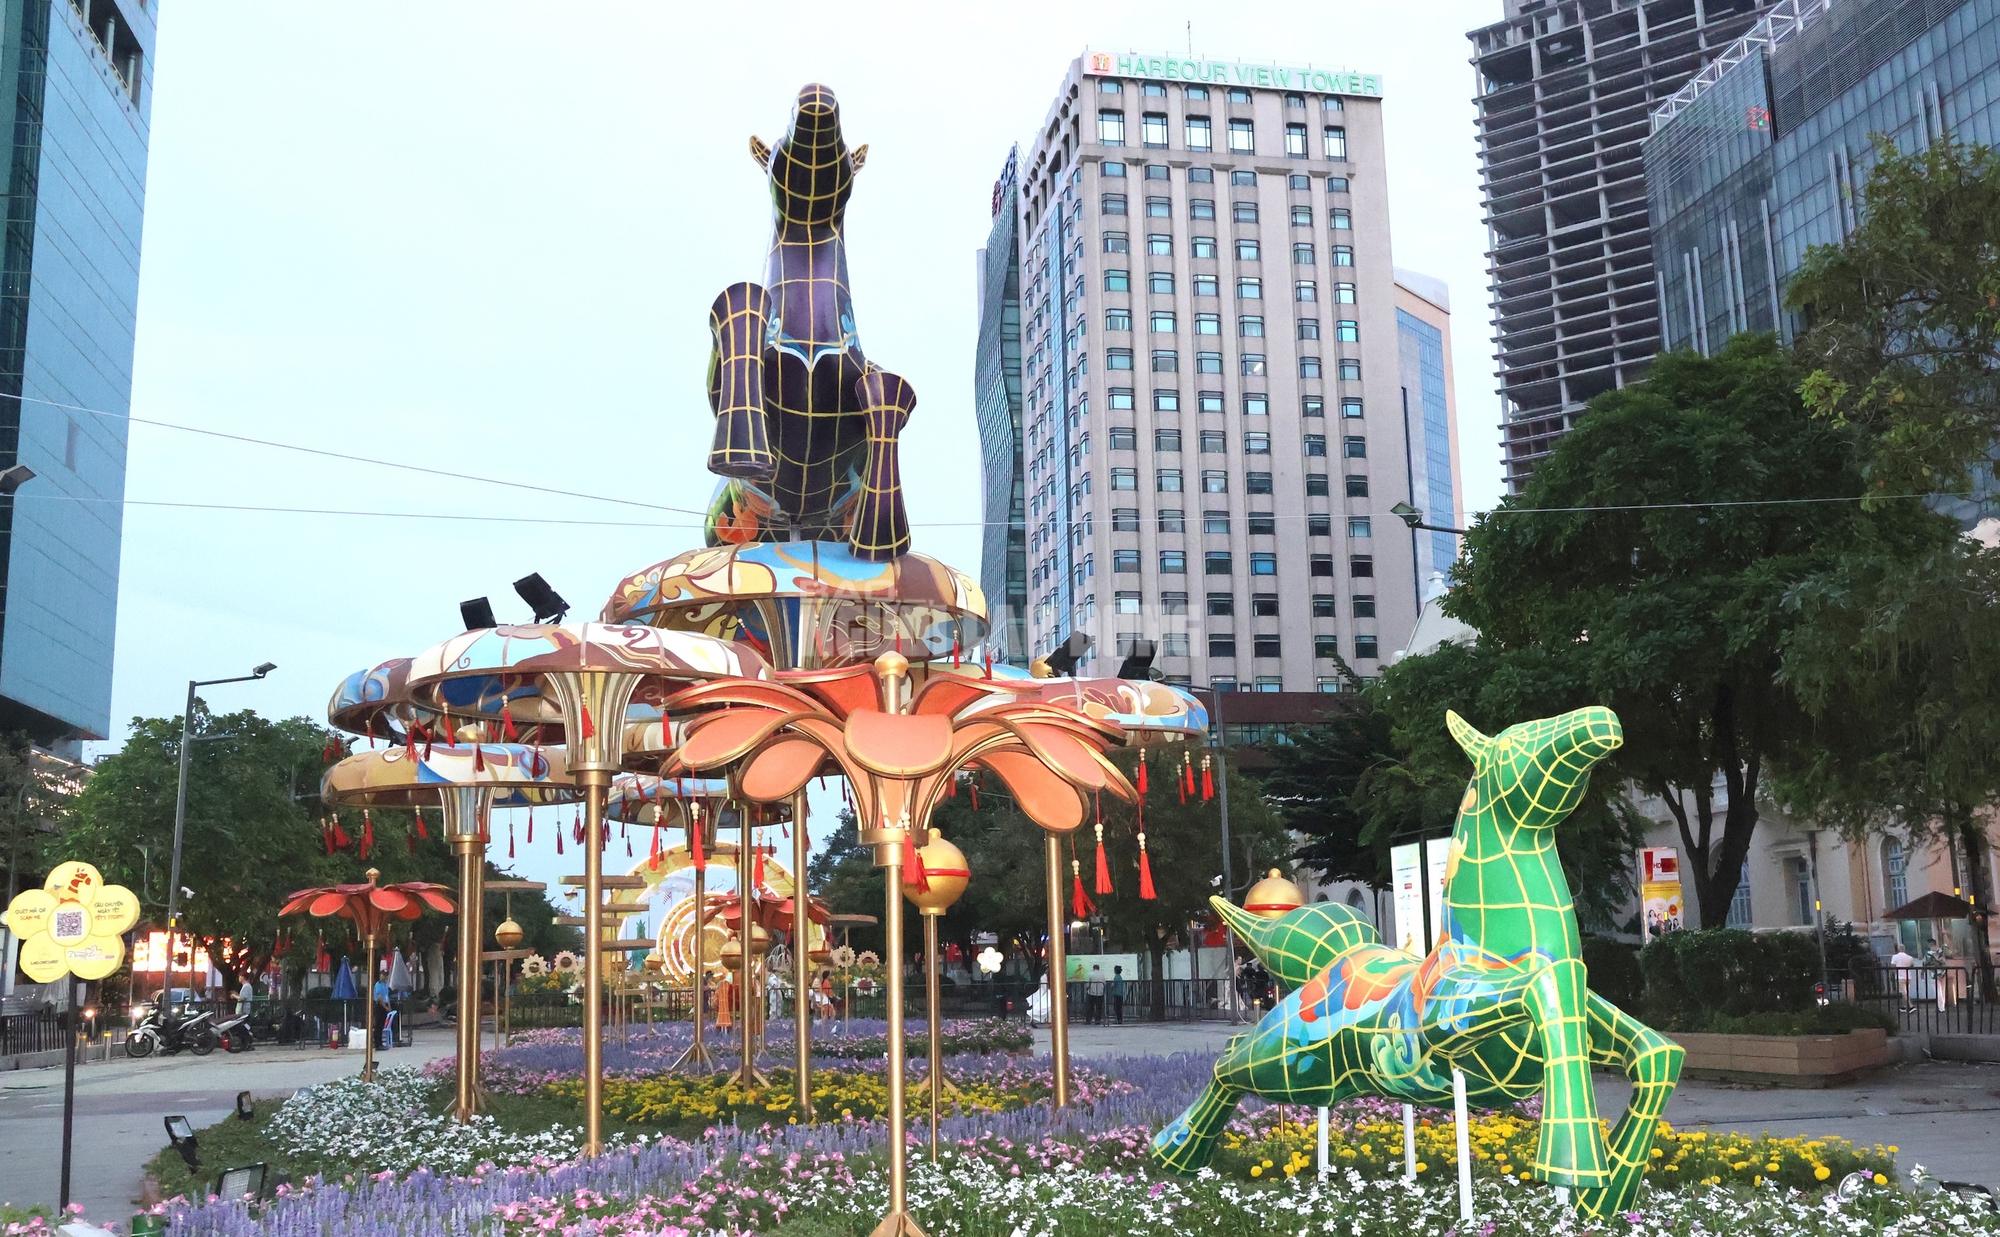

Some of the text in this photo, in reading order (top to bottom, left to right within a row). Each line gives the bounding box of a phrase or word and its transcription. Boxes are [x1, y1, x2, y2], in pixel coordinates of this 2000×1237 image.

[1117, 55, 1379, 96] HARBOUR VIEW TOWER
